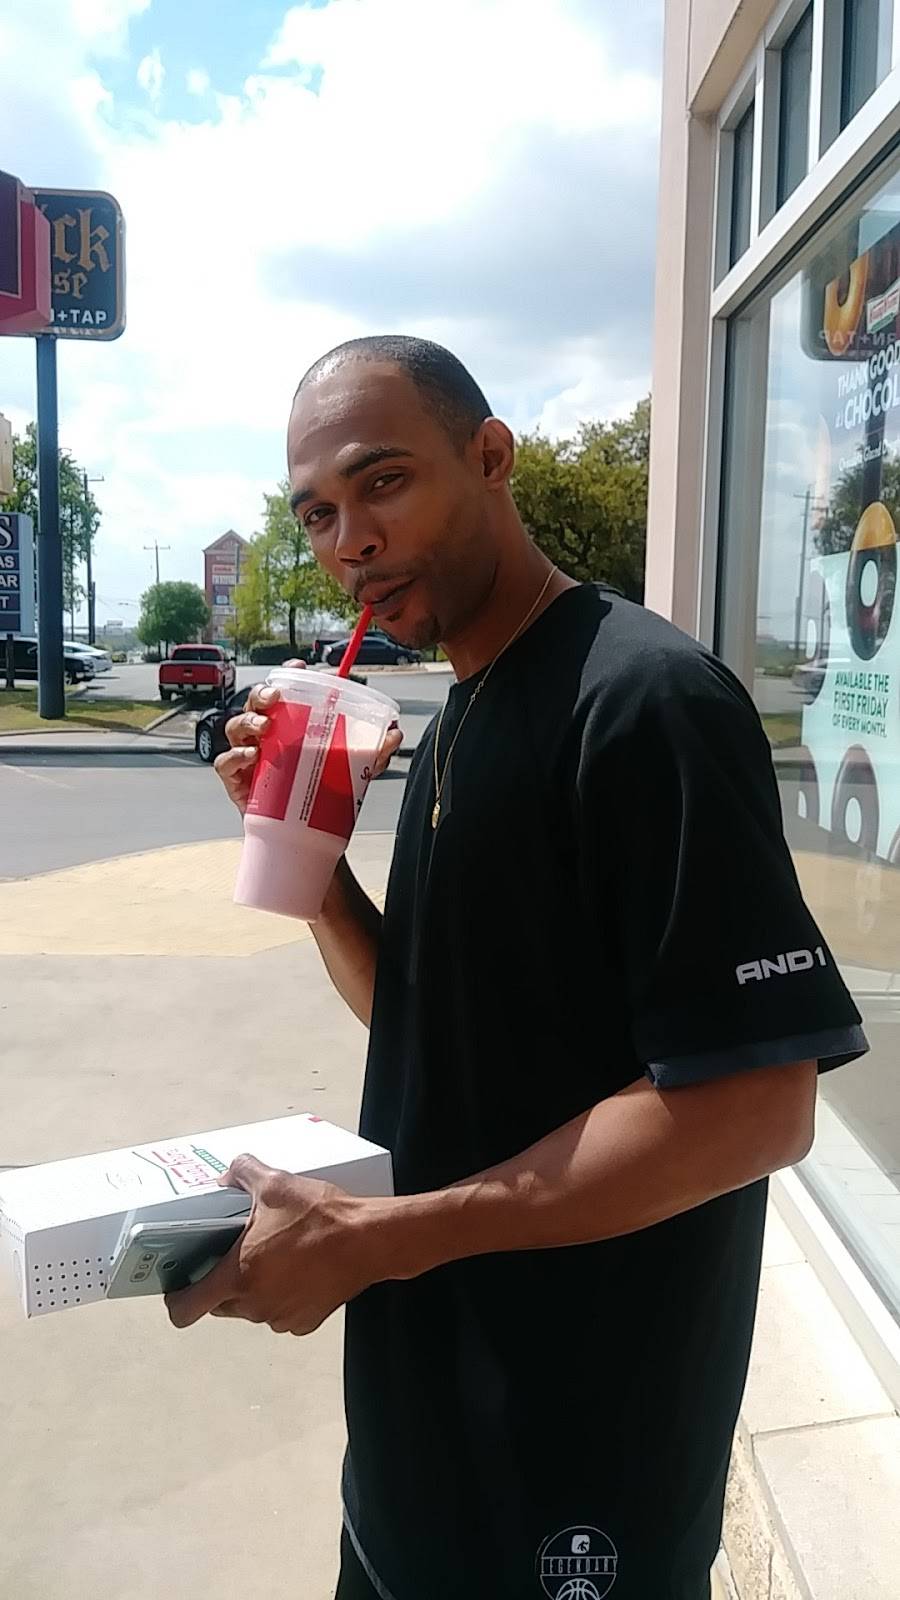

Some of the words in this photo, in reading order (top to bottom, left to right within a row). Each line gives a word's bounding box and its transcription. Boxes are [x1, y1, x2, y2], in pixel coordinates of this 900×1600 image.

[41, 204, 112, 272] ck
[838, 359, 870, 399] THANK
[835, 672, 872, 690] AVAILABLE
[874, 674, 890, 693] THE
[834, 691, 855, 713] FIRST
[856, 694, 889, 718] FRIDAY
[832, 713, 841, 727] OF
[842, 715, 860, 731] EVERY
[735, 946, 827, 985] AND1
[541, 1557, 618, 1574] LEGENDARY
